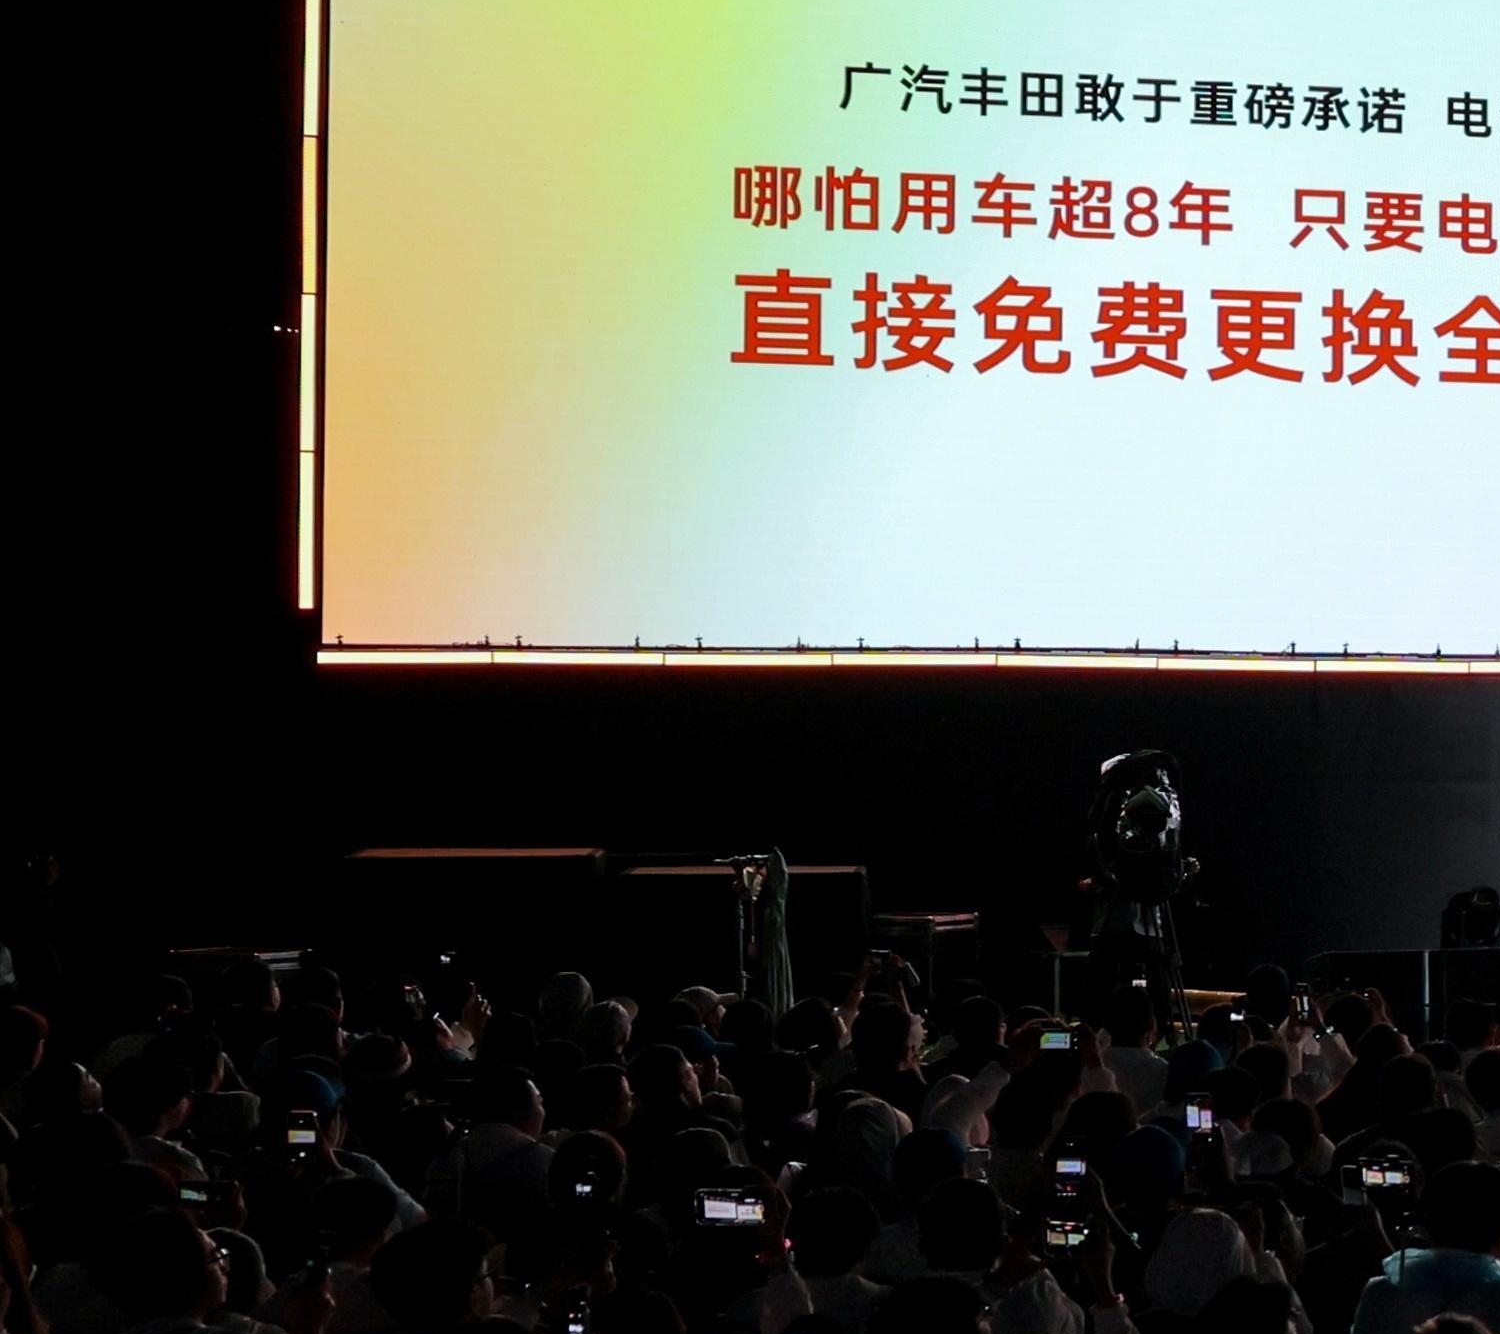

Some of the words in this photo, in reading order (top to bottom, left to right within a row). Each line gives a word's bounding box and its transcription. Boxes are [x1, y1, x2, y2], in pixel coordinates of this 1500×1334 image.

[839, 61, 1406, 135] 广汽丰田敢于重磅承诺
[733, 165, 1234, 246] 哪怕用车超8年
